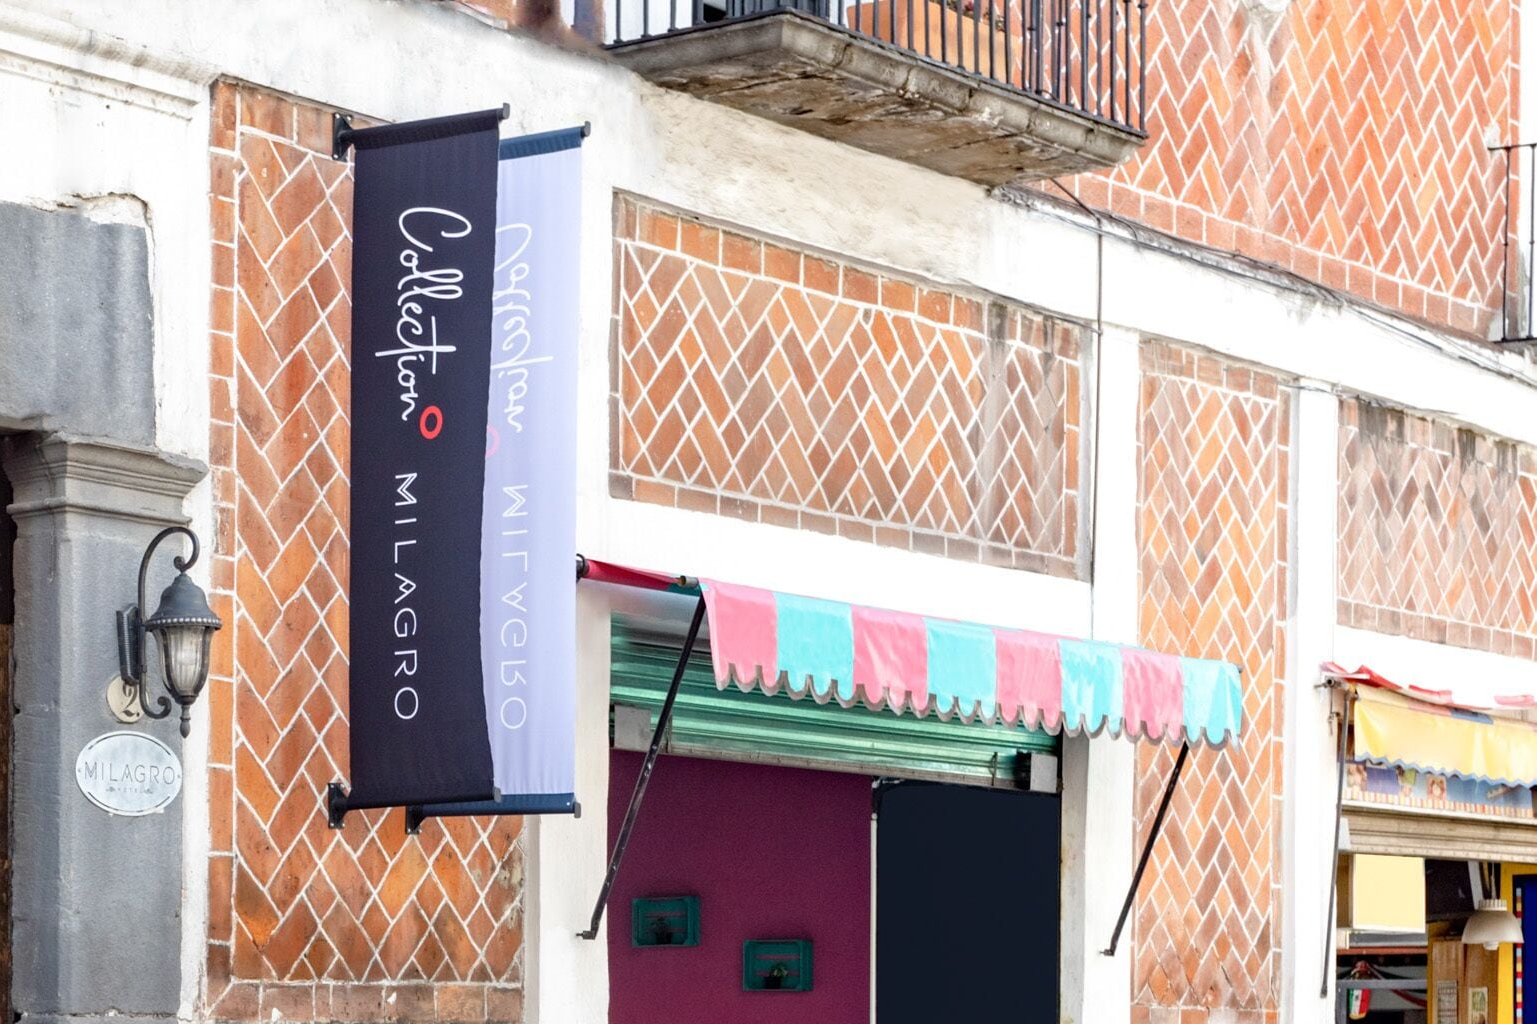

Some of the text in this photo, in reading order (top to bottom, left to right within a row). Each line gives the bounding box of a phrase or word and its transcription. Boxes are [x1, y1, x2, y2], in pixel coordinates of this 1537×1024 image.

[374, 207, 472, 720] Collection MILAGRO
[83, 761, 176, 785] MILAGRO
